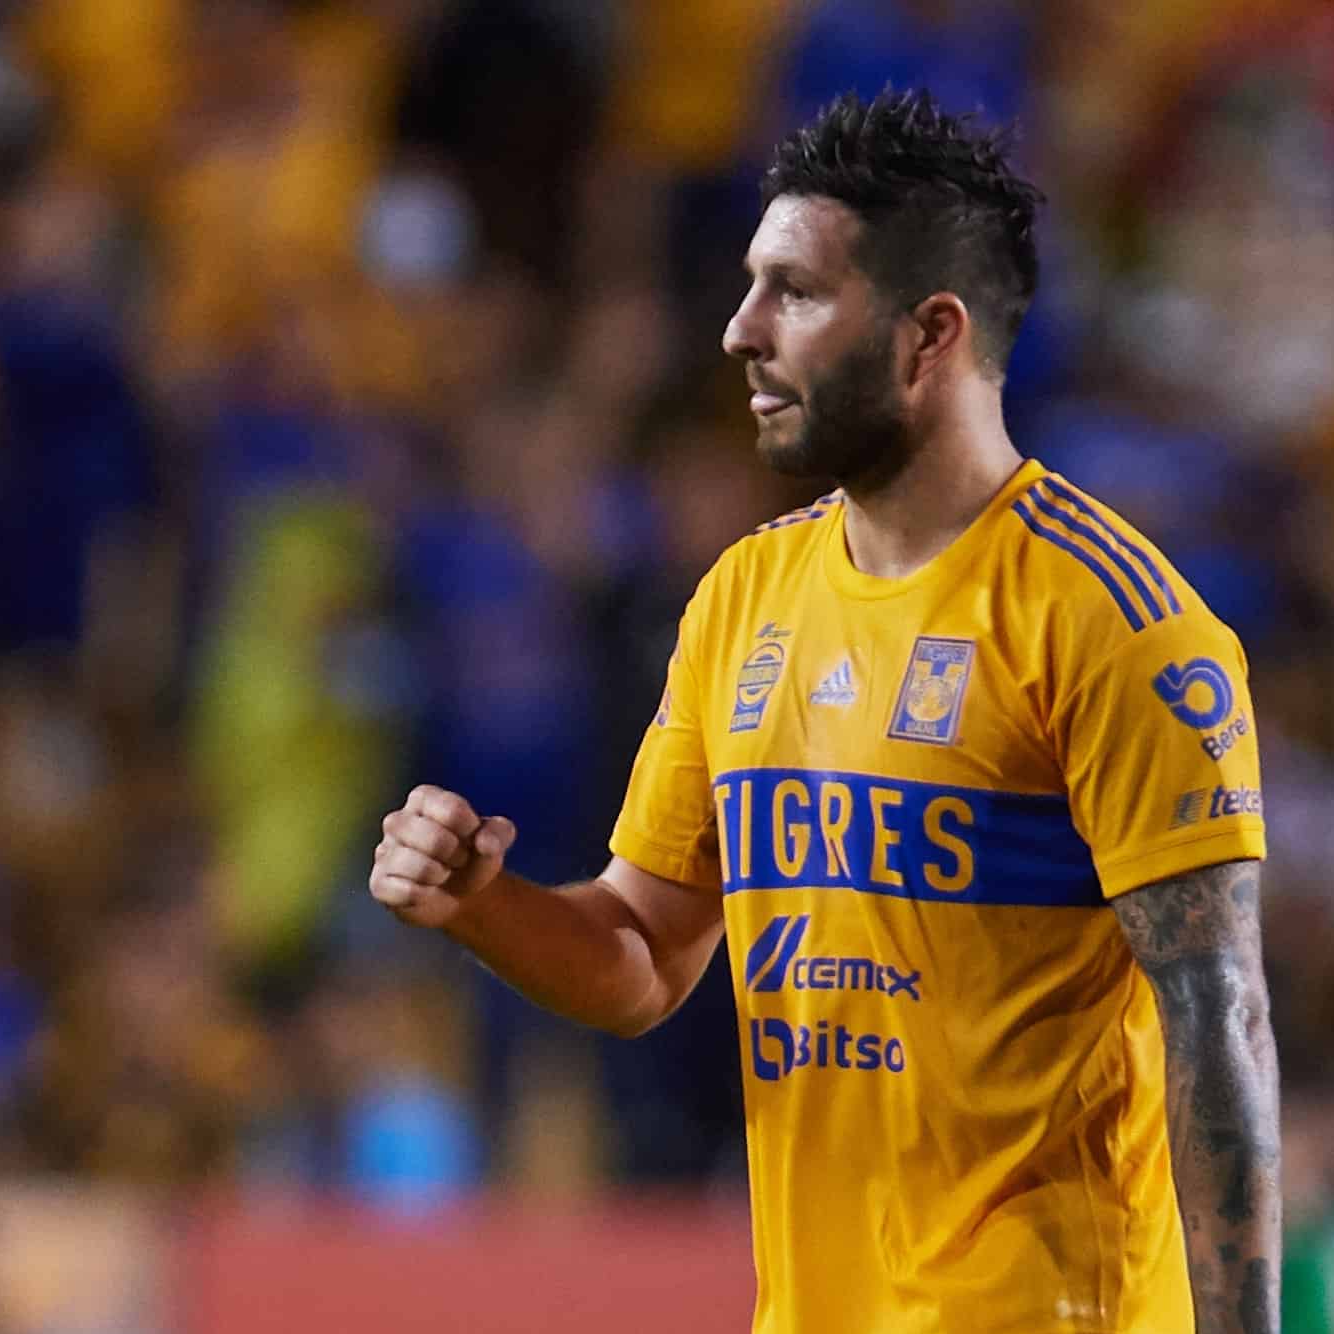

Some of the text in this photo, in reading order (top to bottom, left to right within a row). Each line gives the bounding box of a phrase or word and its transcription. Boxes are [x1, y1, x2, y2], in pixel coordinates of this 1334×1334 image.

[1208, 784, 1263, 819] telce
[714, 779, 975, 892] TIGRES
[795, 1020, 905, 1072] Bitso
